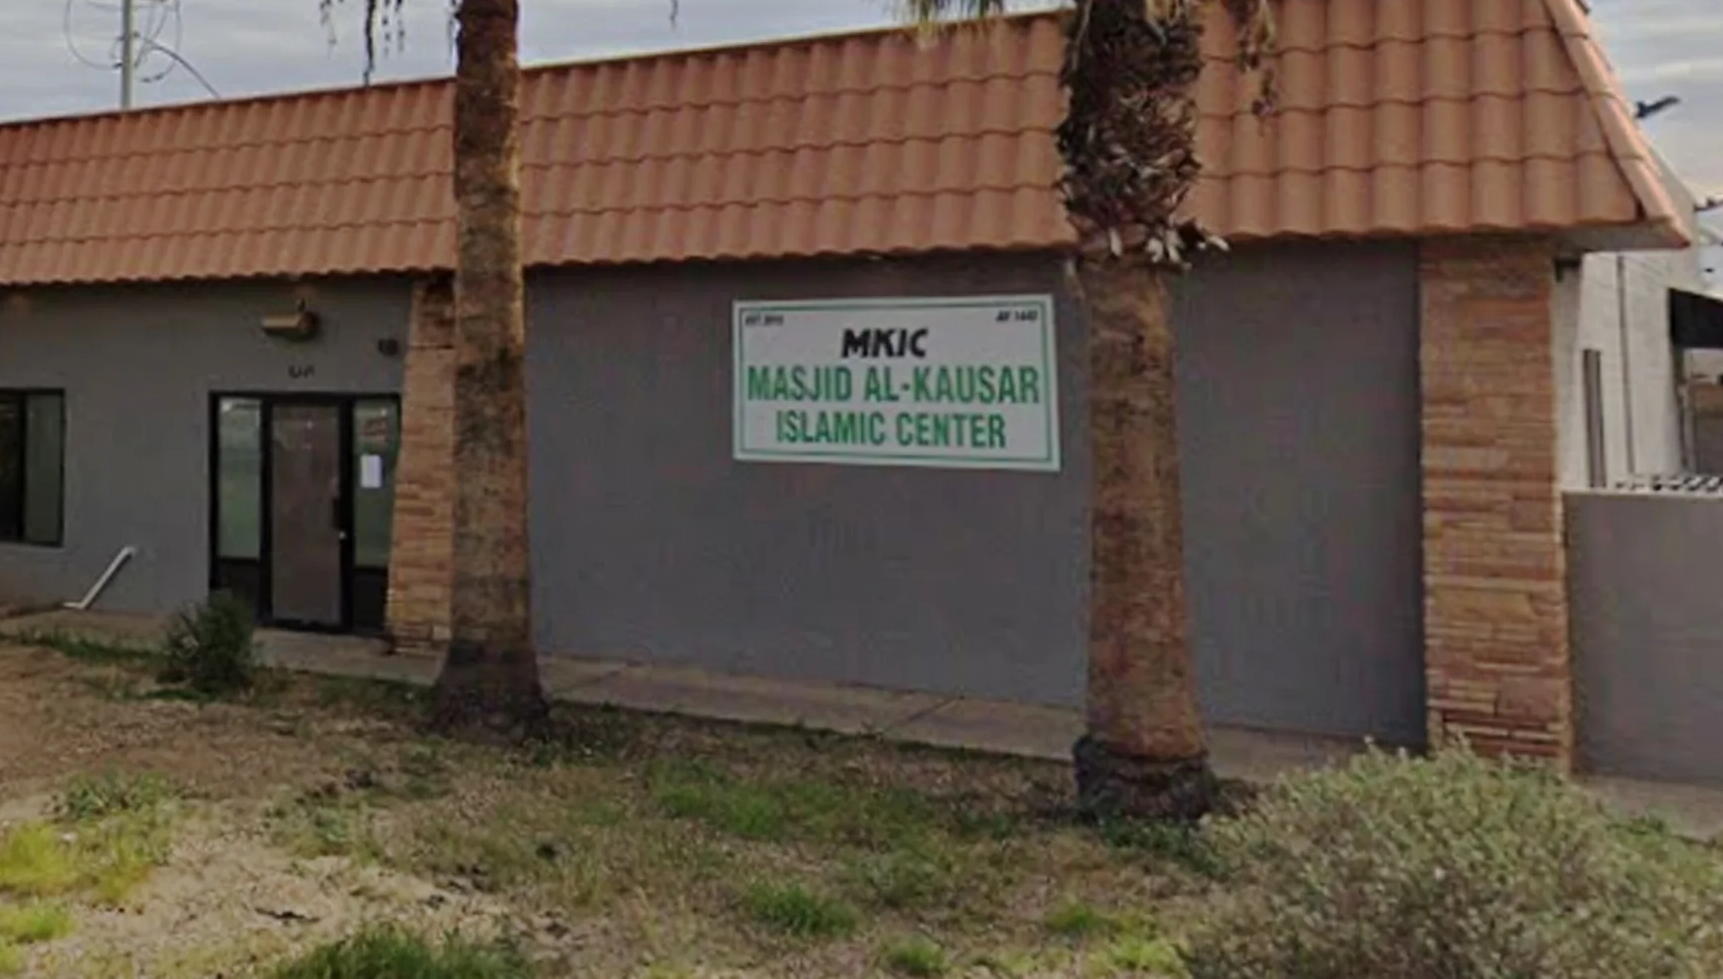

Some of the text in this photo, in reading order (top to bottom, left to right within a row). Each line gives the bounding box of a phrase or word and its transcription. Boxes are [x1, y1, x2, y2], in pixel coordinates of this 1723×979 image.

[841, 327, 930, 359] MKIC
[748, 364, 1040, 404] MASJID AL-KAUSAR
[776, 409, 1007, 449] ISLAMIC CENTER
